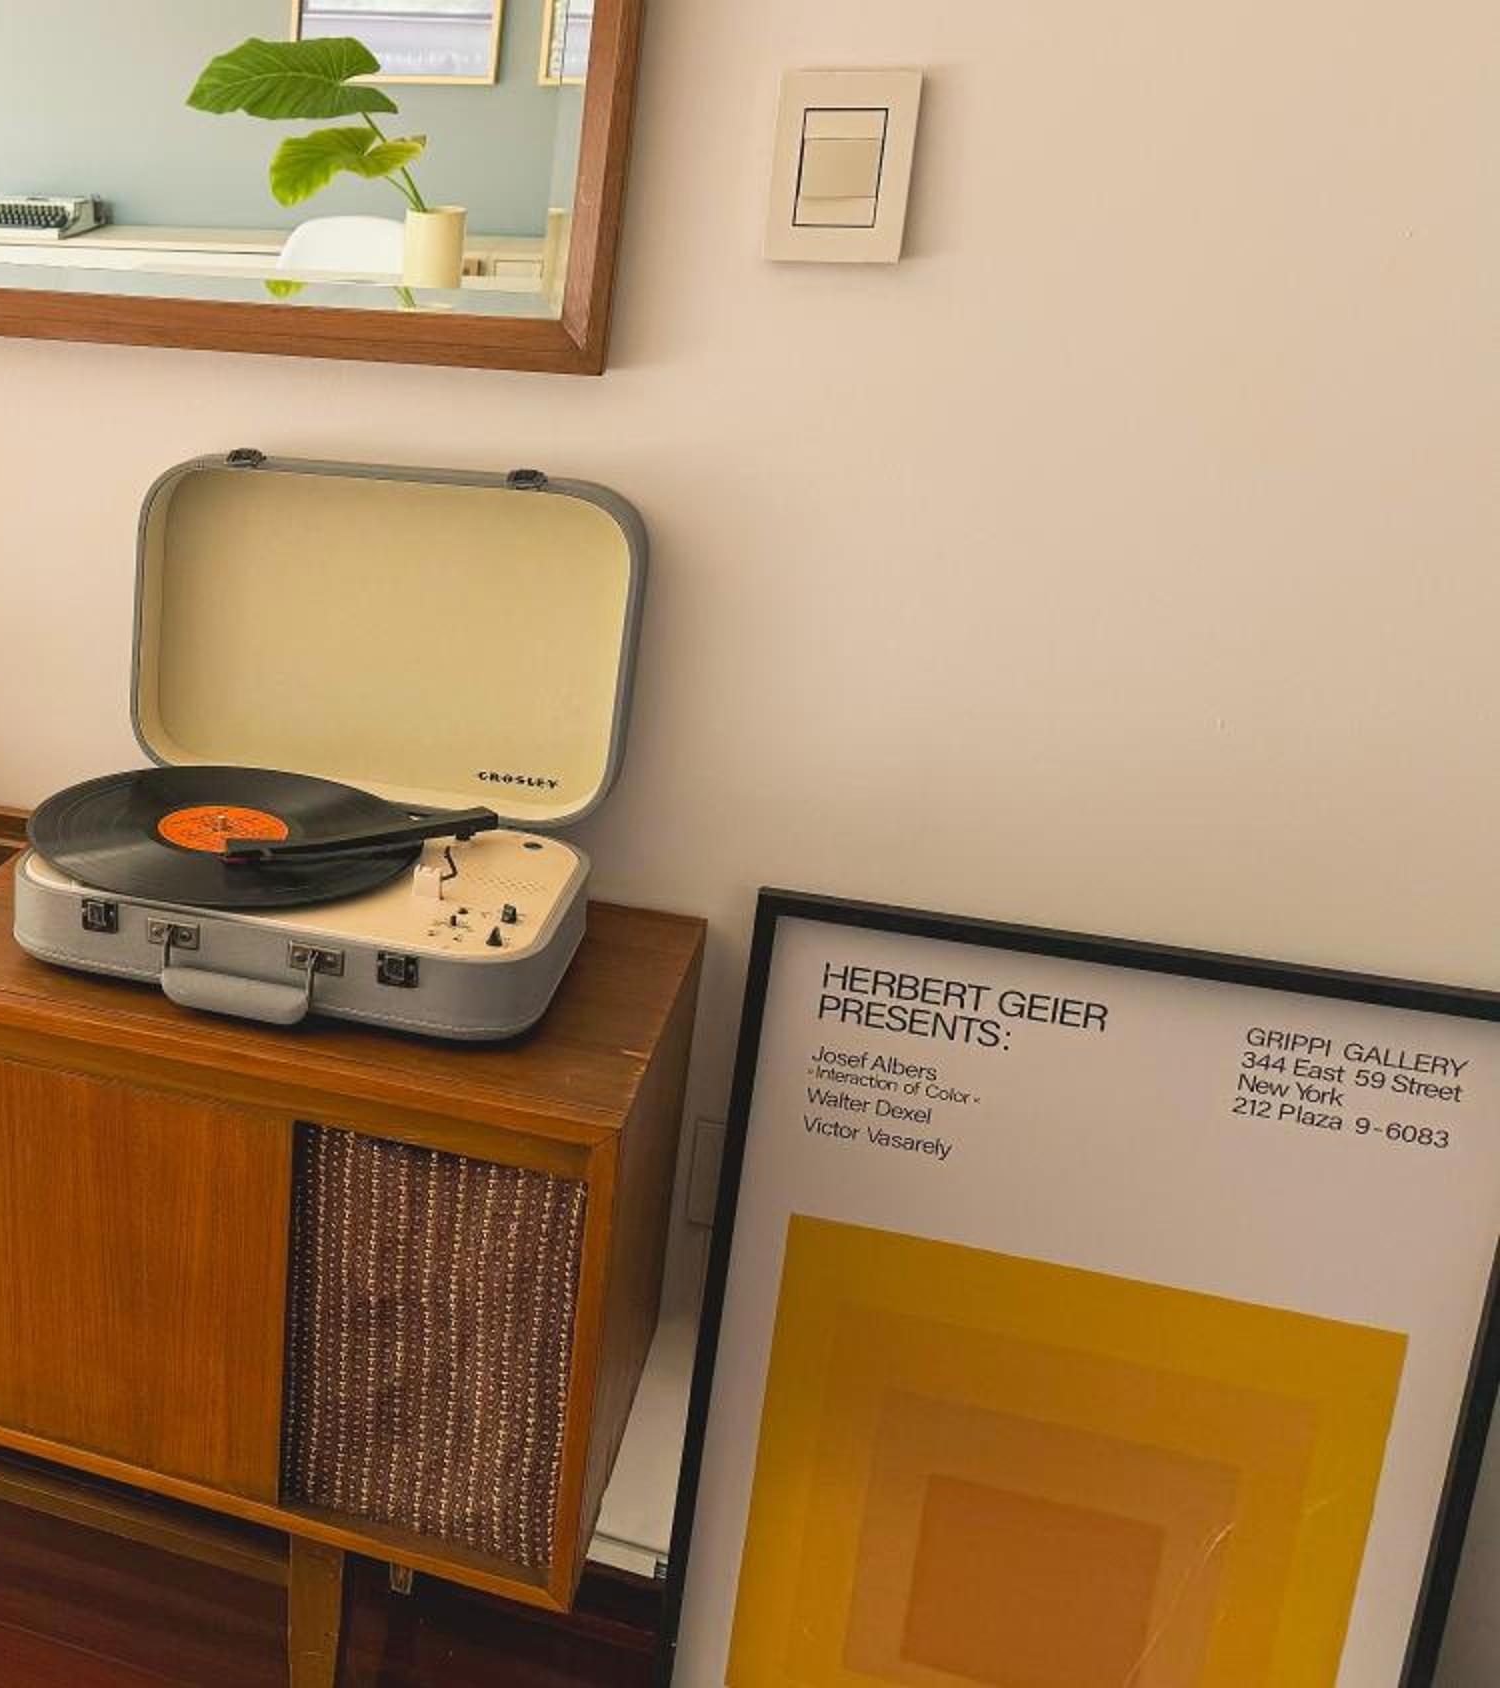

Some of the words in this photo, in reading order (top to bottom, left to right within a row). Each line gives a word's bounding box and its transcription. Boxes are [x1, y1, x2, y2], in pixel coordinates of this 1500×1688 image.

[478, 771, 558, 789] CROSLEY
[822, 962, 991, 1011] HERBERT
[998, 990, 1109, 1031] GEIER
[817, 994, 1011, 1051] PRESENTS:
[811, 1046, 869, 1069] Josef
[871, 1055, 937, 1081] Albers
[1247, 1027, 1331, 1057] GRIPPI
[1343, 1043, 1469, 1078] GALLERY
[903, 1082, 921, 1097] of
[1237, 1073, 1289, 1098] New
[1295, 1082, 1343, 1107] York
[1241, 1052, 1287, 1073] 344
[1293, 1059, 1346, 1083] East
[1355, 1069, 1386, 1089] 59
[1391, 1074, 1463, 1103] Street
[807, 1088, 871, 1113] Walter
[875, 1099, 932, 1124] Dexel
[1232, 1097, 1271, 1119] 212
[1278, 1103, 1343, 1131] Plaza
[1355, 1117, 1450, 1149] 9-6083
[803, 1115, 860, 1140] Victor
[867, 1126, 952, 1161] Vasarely
